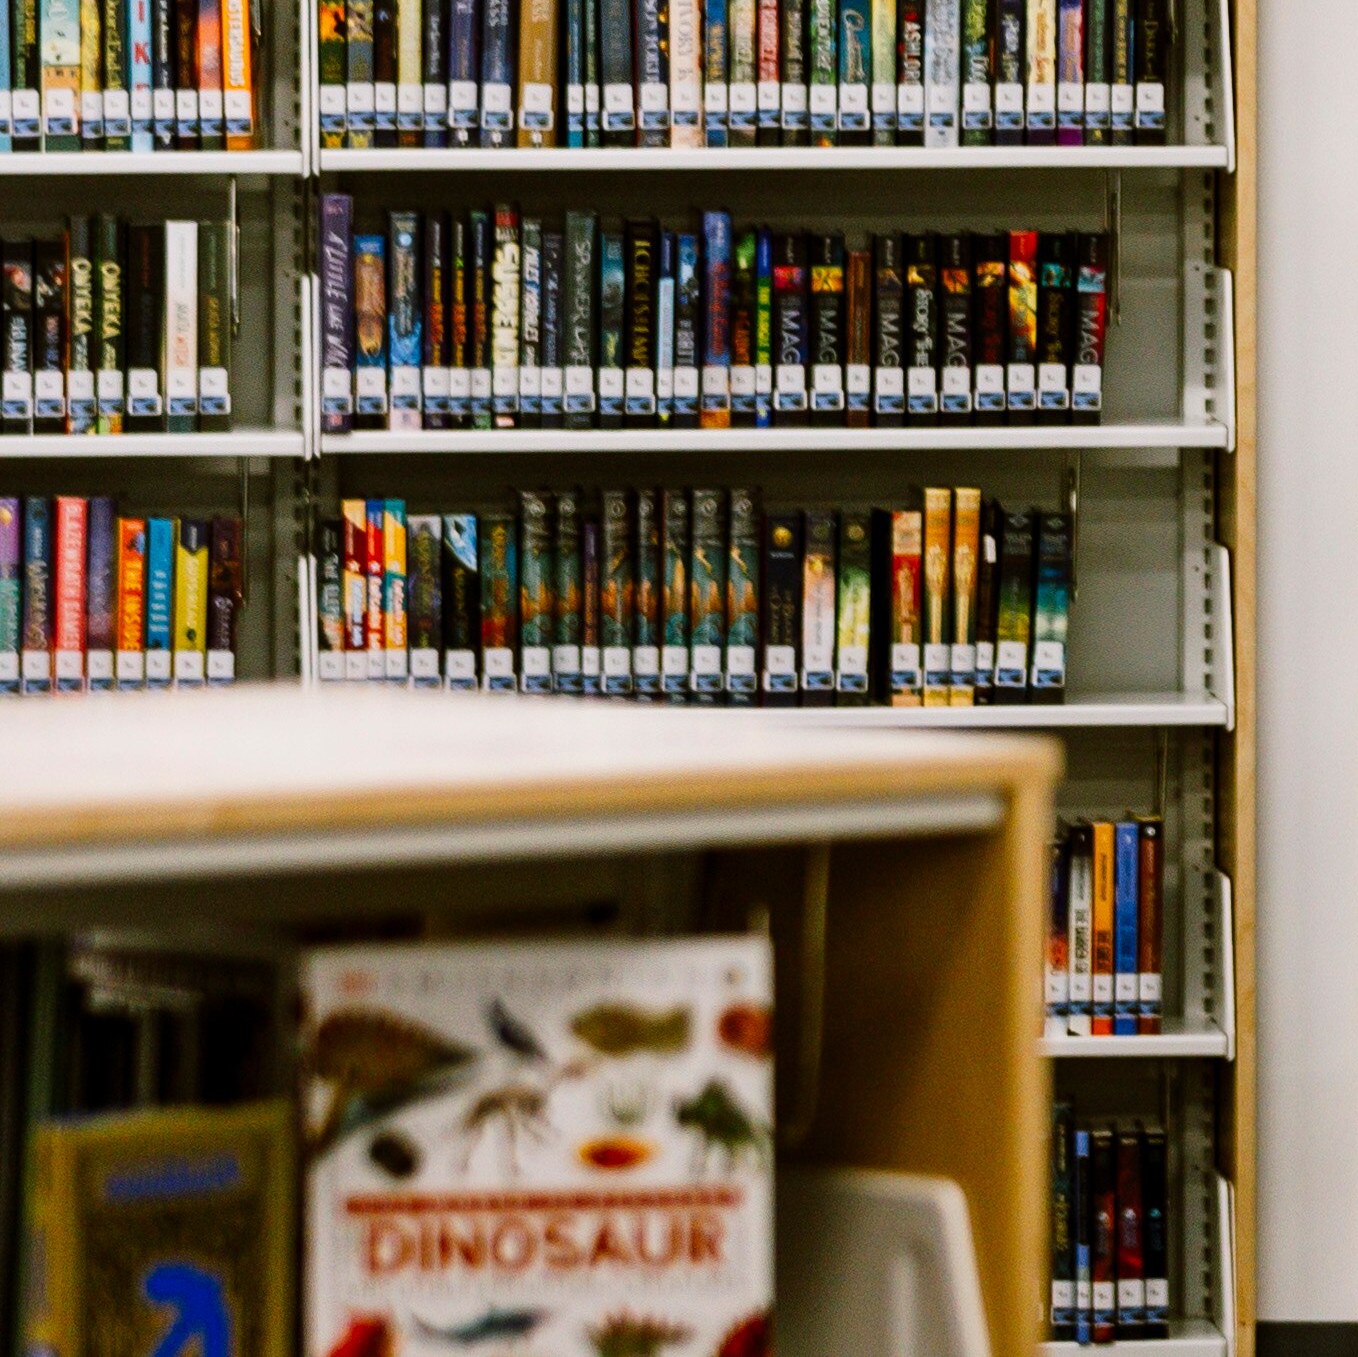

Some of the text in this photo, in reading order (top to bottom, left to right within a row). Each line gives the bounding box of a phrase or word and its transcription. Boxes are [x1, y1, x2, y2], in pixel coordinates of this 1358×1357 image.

[904, 20, 921, 85] ASHLOR
[72, 257, 92, 336] ONYEKA
[101, 261, 121, 339] ONYEKA
[492, 242, 520, 368] SUSPEND
[781, 309, 801, 364] MAG
[819, 309, 838, 362] MAG
[880, 311, 900, 367] MAG
[946, 311, 967, 368] MAG
[1079, 309, 1100, 364] MAG
[365, 1210, 726, 1276] DINOSAUR
